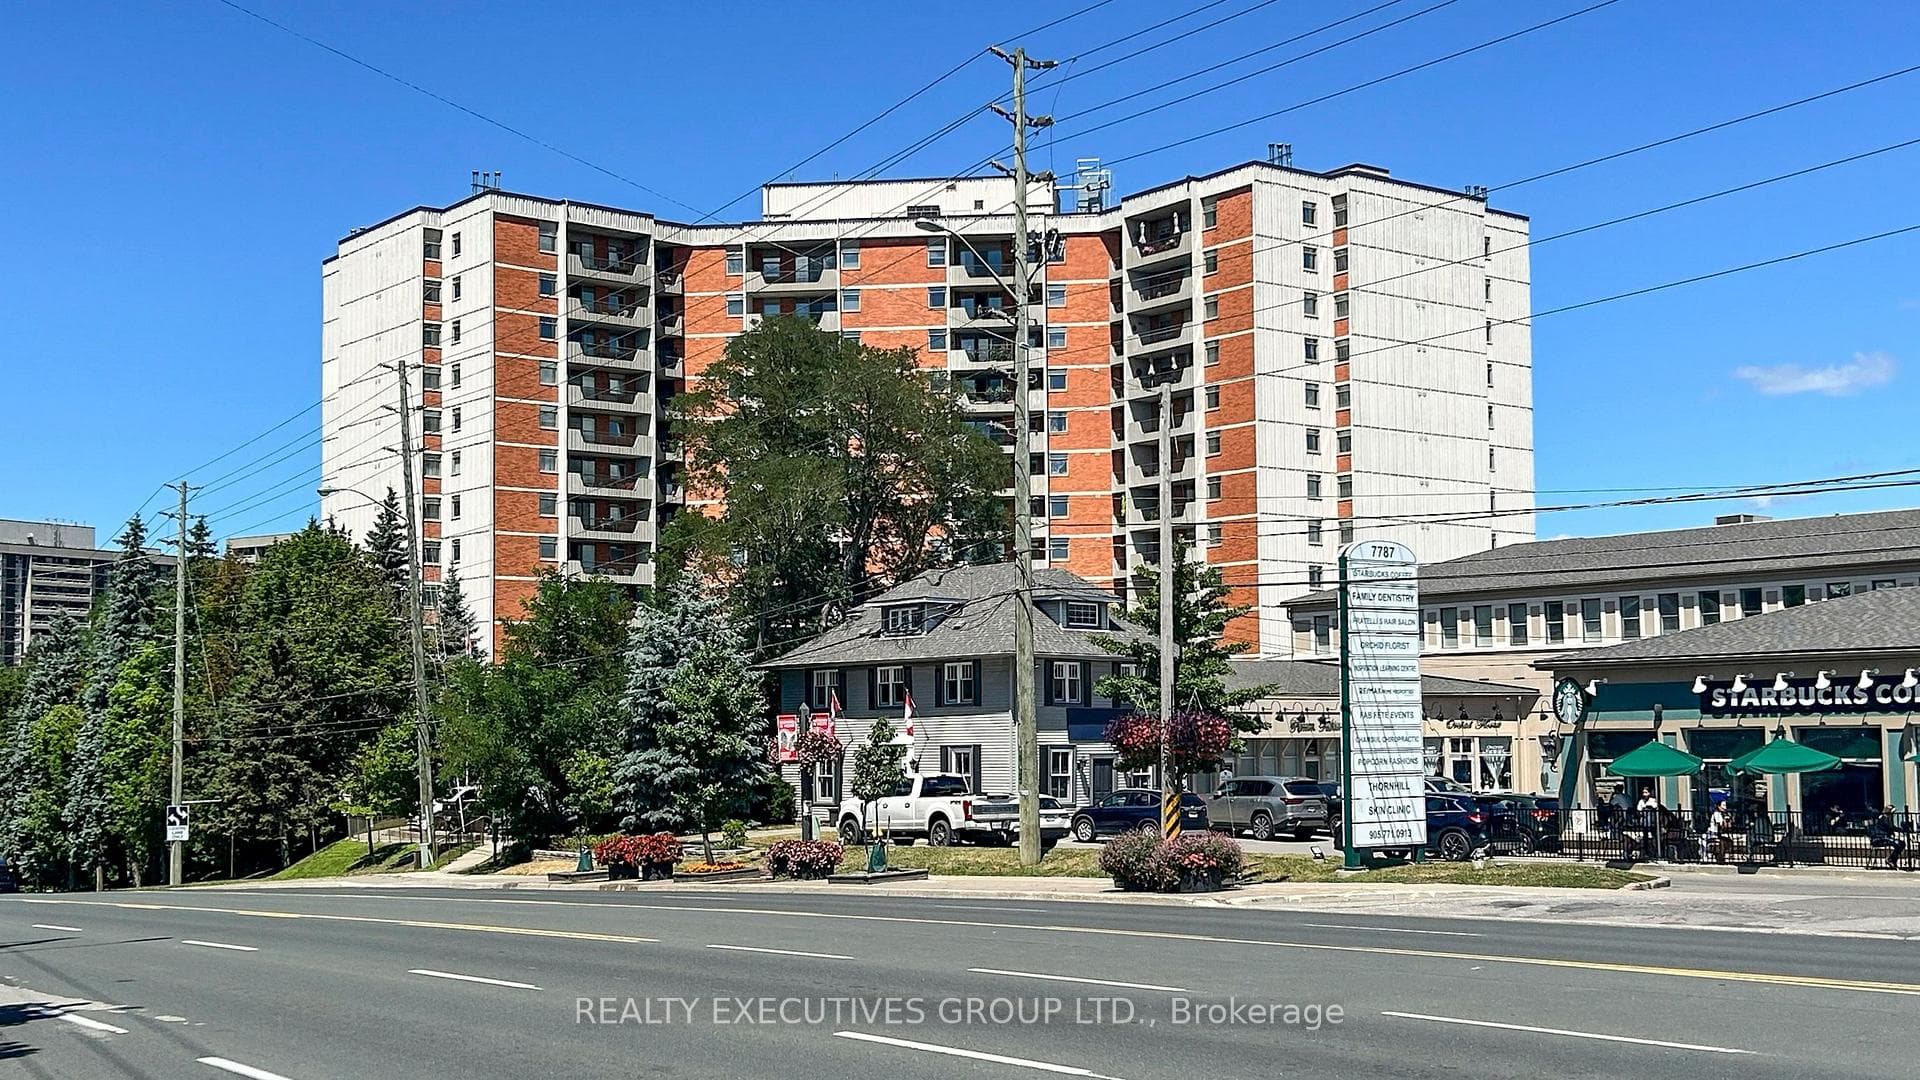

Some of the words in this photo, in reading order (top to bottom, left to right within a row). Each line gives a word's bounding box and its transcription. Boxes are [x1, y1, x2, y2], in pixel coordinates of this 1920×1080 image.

[1371, 545, 1395, 558] 7787
[1352, 568, 1389, 578] STARBUCKS
[1352, 591, 1377, 601] FAMILY
[1378, 593, 1415, 603] DENTISTRY
[1398, 618, 1416, 626] SALON
[1360, 641, 1384, 650] ORCHID
[1385, 641, 1410, 650] FLORIST
[1711, 685, 1868, 708] STARBUCKS
[1390, 711, 1414, 719] EVENTS
[1358, 757, 1388, 765] POPCORN
[1389, 757, 1419, 765] FASHIONS
[1369, 781, 1410, 791] THORNHILL
[1368, 805, 1386, 815] SKIN
[1387, 804, 1411, 815] CLINIC
